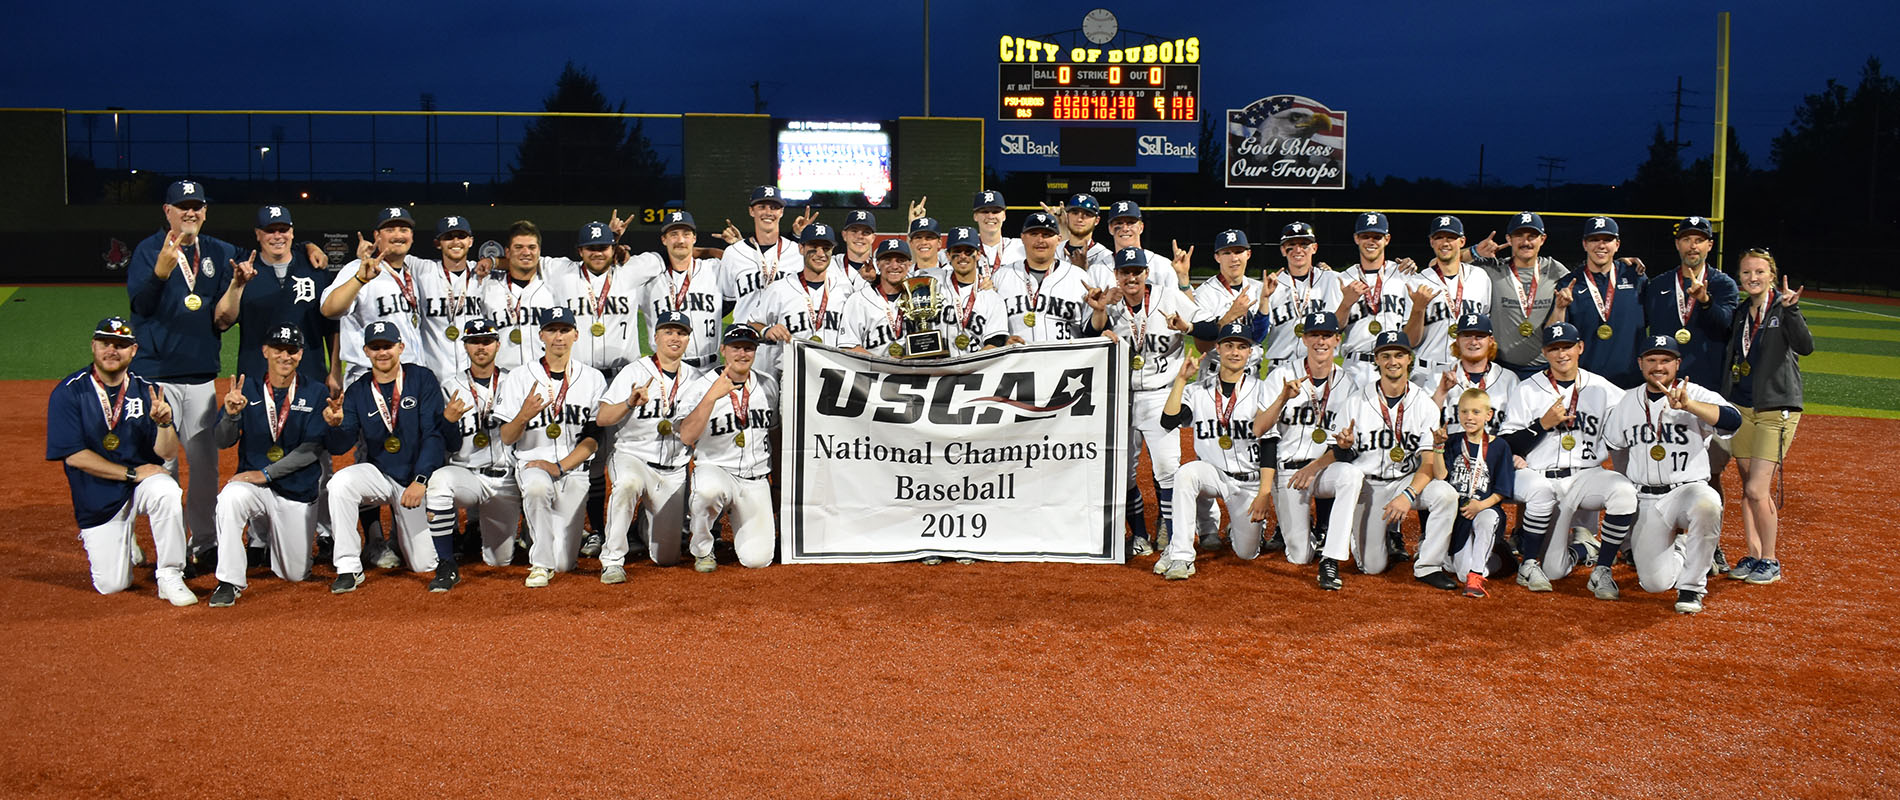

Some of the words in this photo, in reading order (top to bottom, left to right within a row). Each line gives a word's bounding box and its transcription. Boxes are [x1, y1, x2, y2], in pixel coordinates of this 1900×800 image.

[1000, 35, 1059, 62] CITY
[1071, 47, 1101, 63] OF
[1109, 37, 1199, 63] DUBOIS
[1034, 71, 1057, 79] BALL
[1059, 66, 1071, 84] 0
[1077, 71, 1108, 79] STRIKE
[1109, 66, 1121, 84] 0
[1129, 71, 1148, 79] OUT
[1150, 66, 1161, 84] 0
[1027, 141, 1059, 155] Bank
[1164, 142, 1196, 156] Bank
[1237, 137, 1278, 155] God
[1280, 138, 1334, 156] Bless
[1231, 158, 1269, 177] Our
[1271, 159, 1340, 185] Troops
[643, 208, 677, 222] 31
[1349, 294, 1406, 324] LINS
[1424, 298, 1482, 325] LINS
[620, 321, 627, 340] 7
[704, 318, 716, 338] 13
[1055, 322, 1072, 340] 35
[1154, 356, 1168, 374] 12
[815, 366, 1097, 425] USCAA
[1623, 423, 1689, 448] LIONS
[813, 434, 932, 465] National
[943, 435, 1098, 468] Champions
[1671, 451, 1689, 472] 17
[894, 473, 1016, 501] Baseball
[920, 513, 987, 539] 2019
